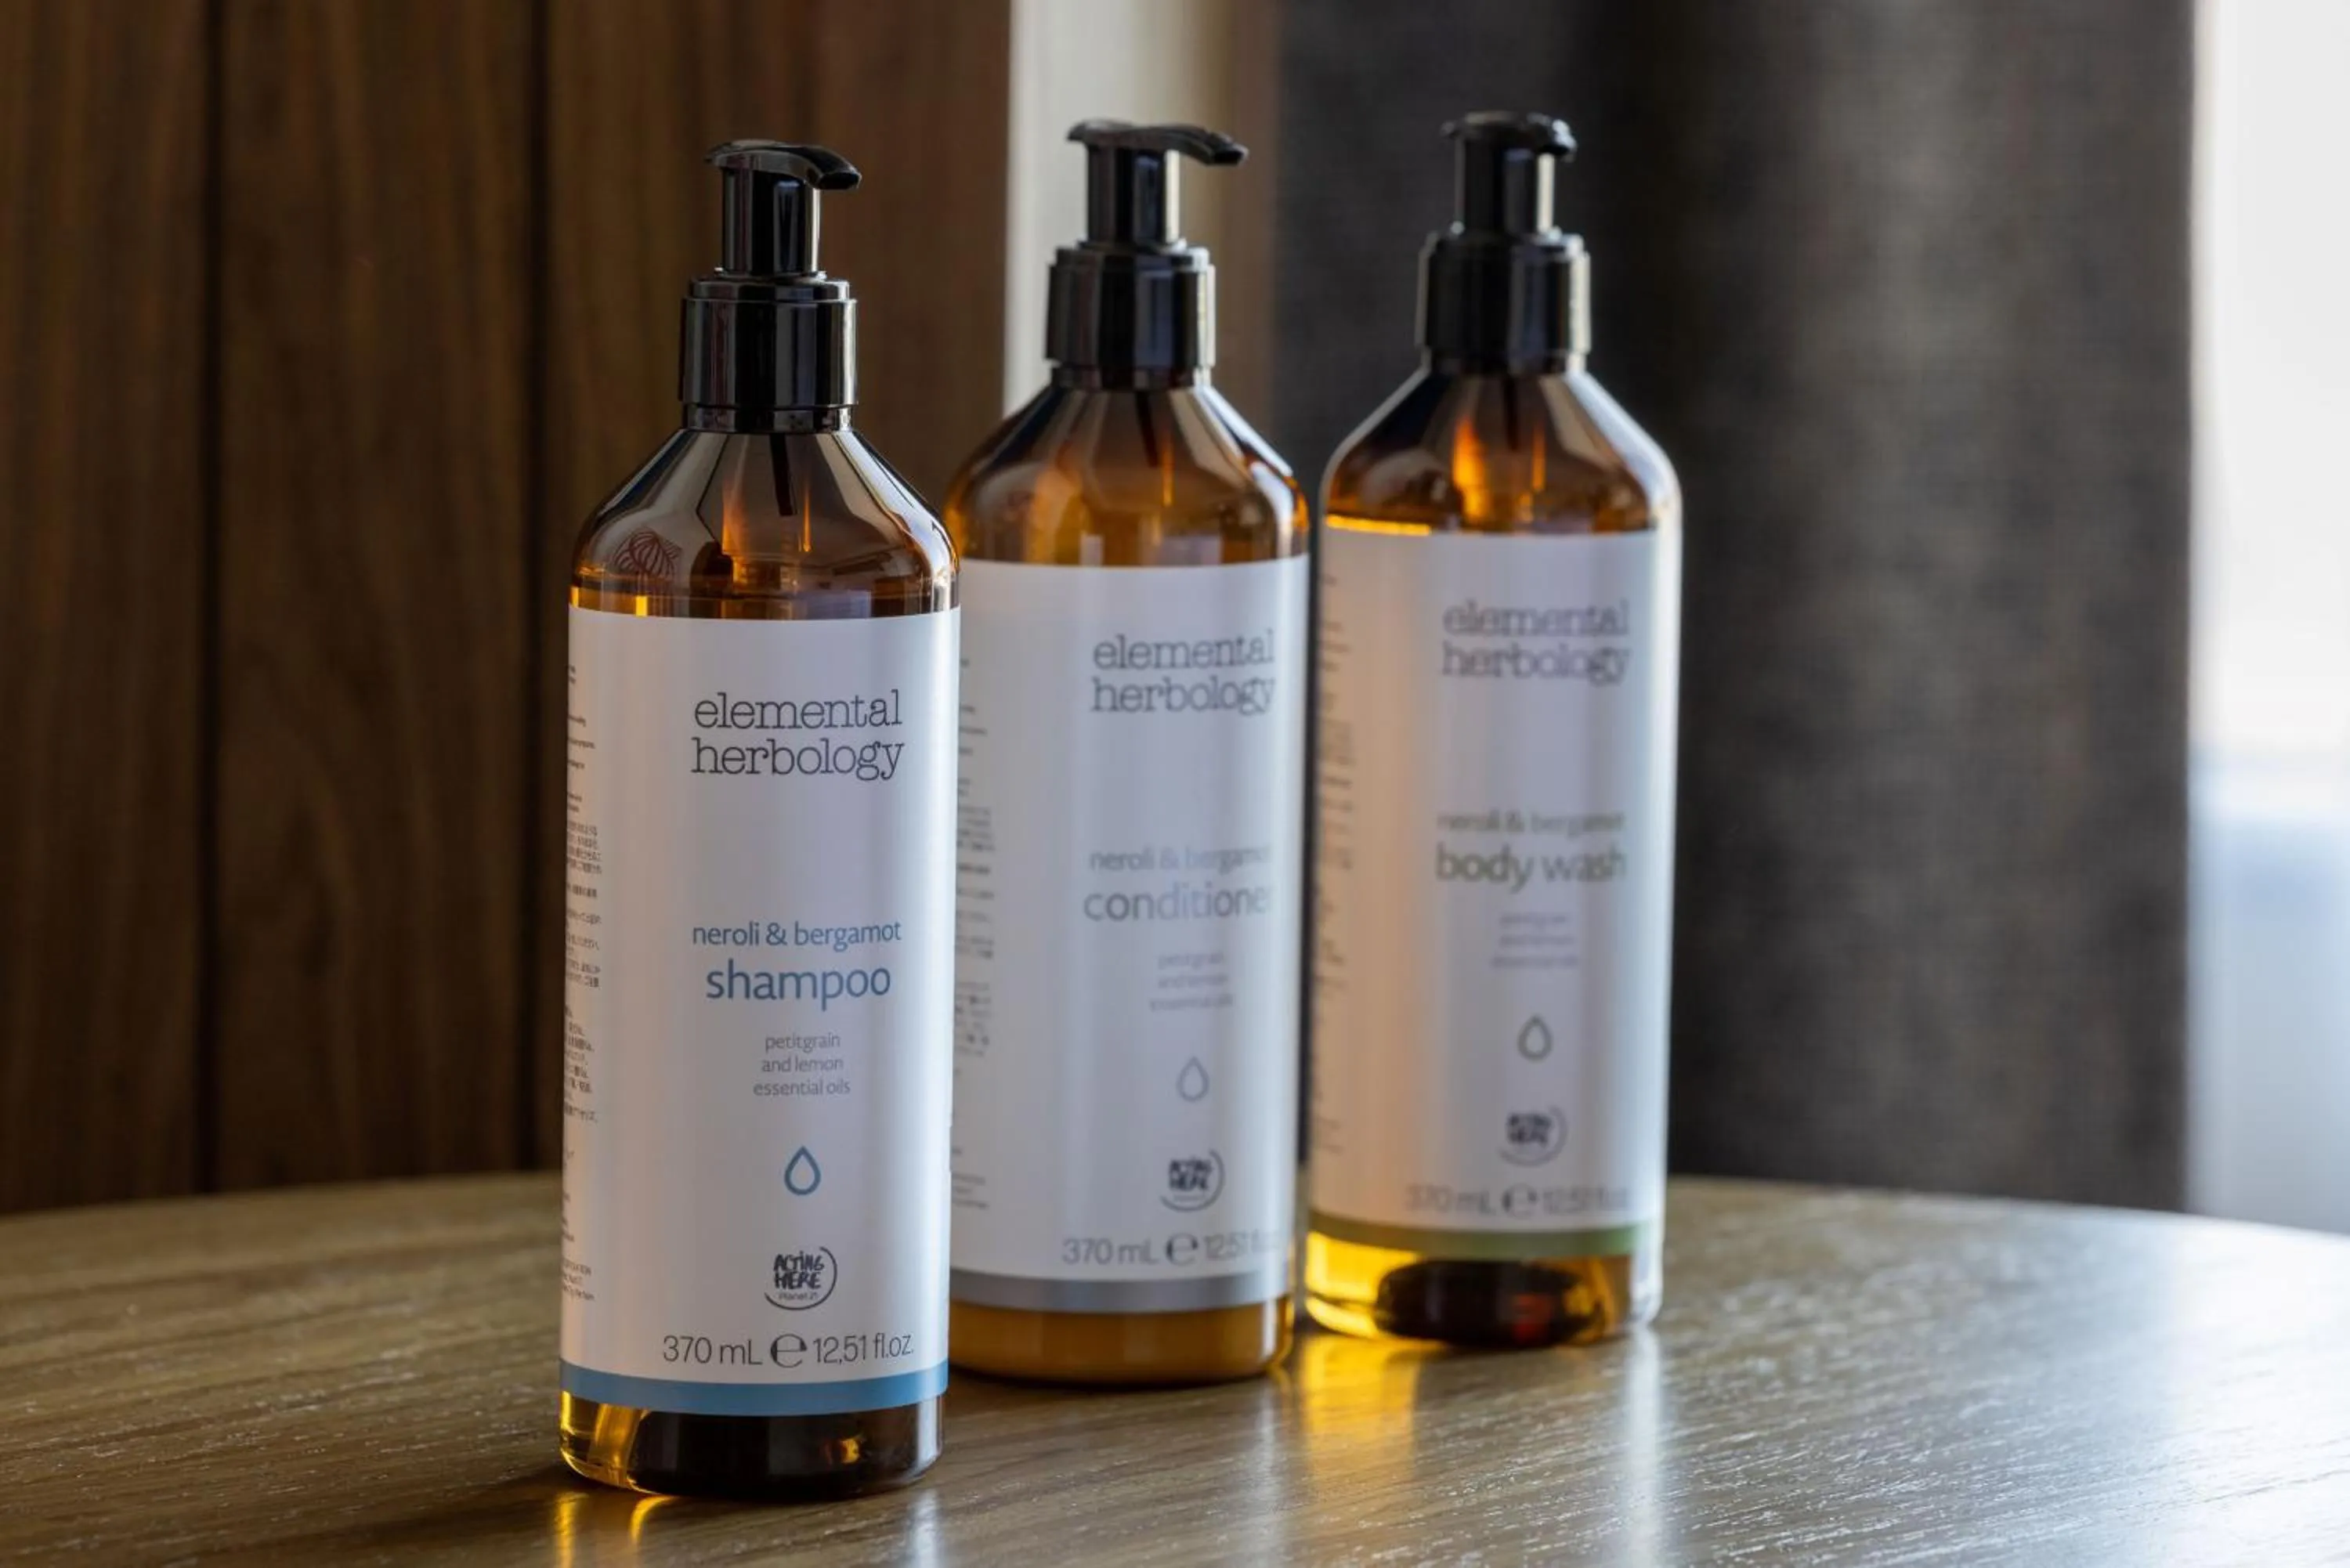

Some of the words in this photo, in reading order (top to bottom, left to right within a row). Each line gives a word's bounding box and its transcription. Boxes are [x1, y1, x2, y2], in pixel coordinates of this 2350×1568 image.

[1441, 598, 1629, 638] elemental
[1092, 629, 1275, 671] elemental
[1441, 641, 1632, 687] herbology
[694, 688, 903, 730] elemental
[1090, 675, 1277, 716] herbology
[691, 737, 906, 782] herbology
[1437, 841, 1535, 894] body
[692, 921, 760, 946] neroli
[765, 923, 788, 946] &
[794, 920, 902, 952] bergamot
[706, 959, 891, 1010] shampoo
[765, 1031, 841, 1052] petitgrain
[761, 1054, 791, 1073] and
[794, 1054, 844, 1073] lemon
[753, 1078, 823, 1096] essential
[825, 1078, 851, 1095] oils
[1062, 1237, 1112, 1266] 370
[775, 1271, 822, 1290] HERE
[663, 1335, 712, 1364] 370
[719, 1339, 763, 1366] mL
[812, 1335, 867, 1365] 12,51
